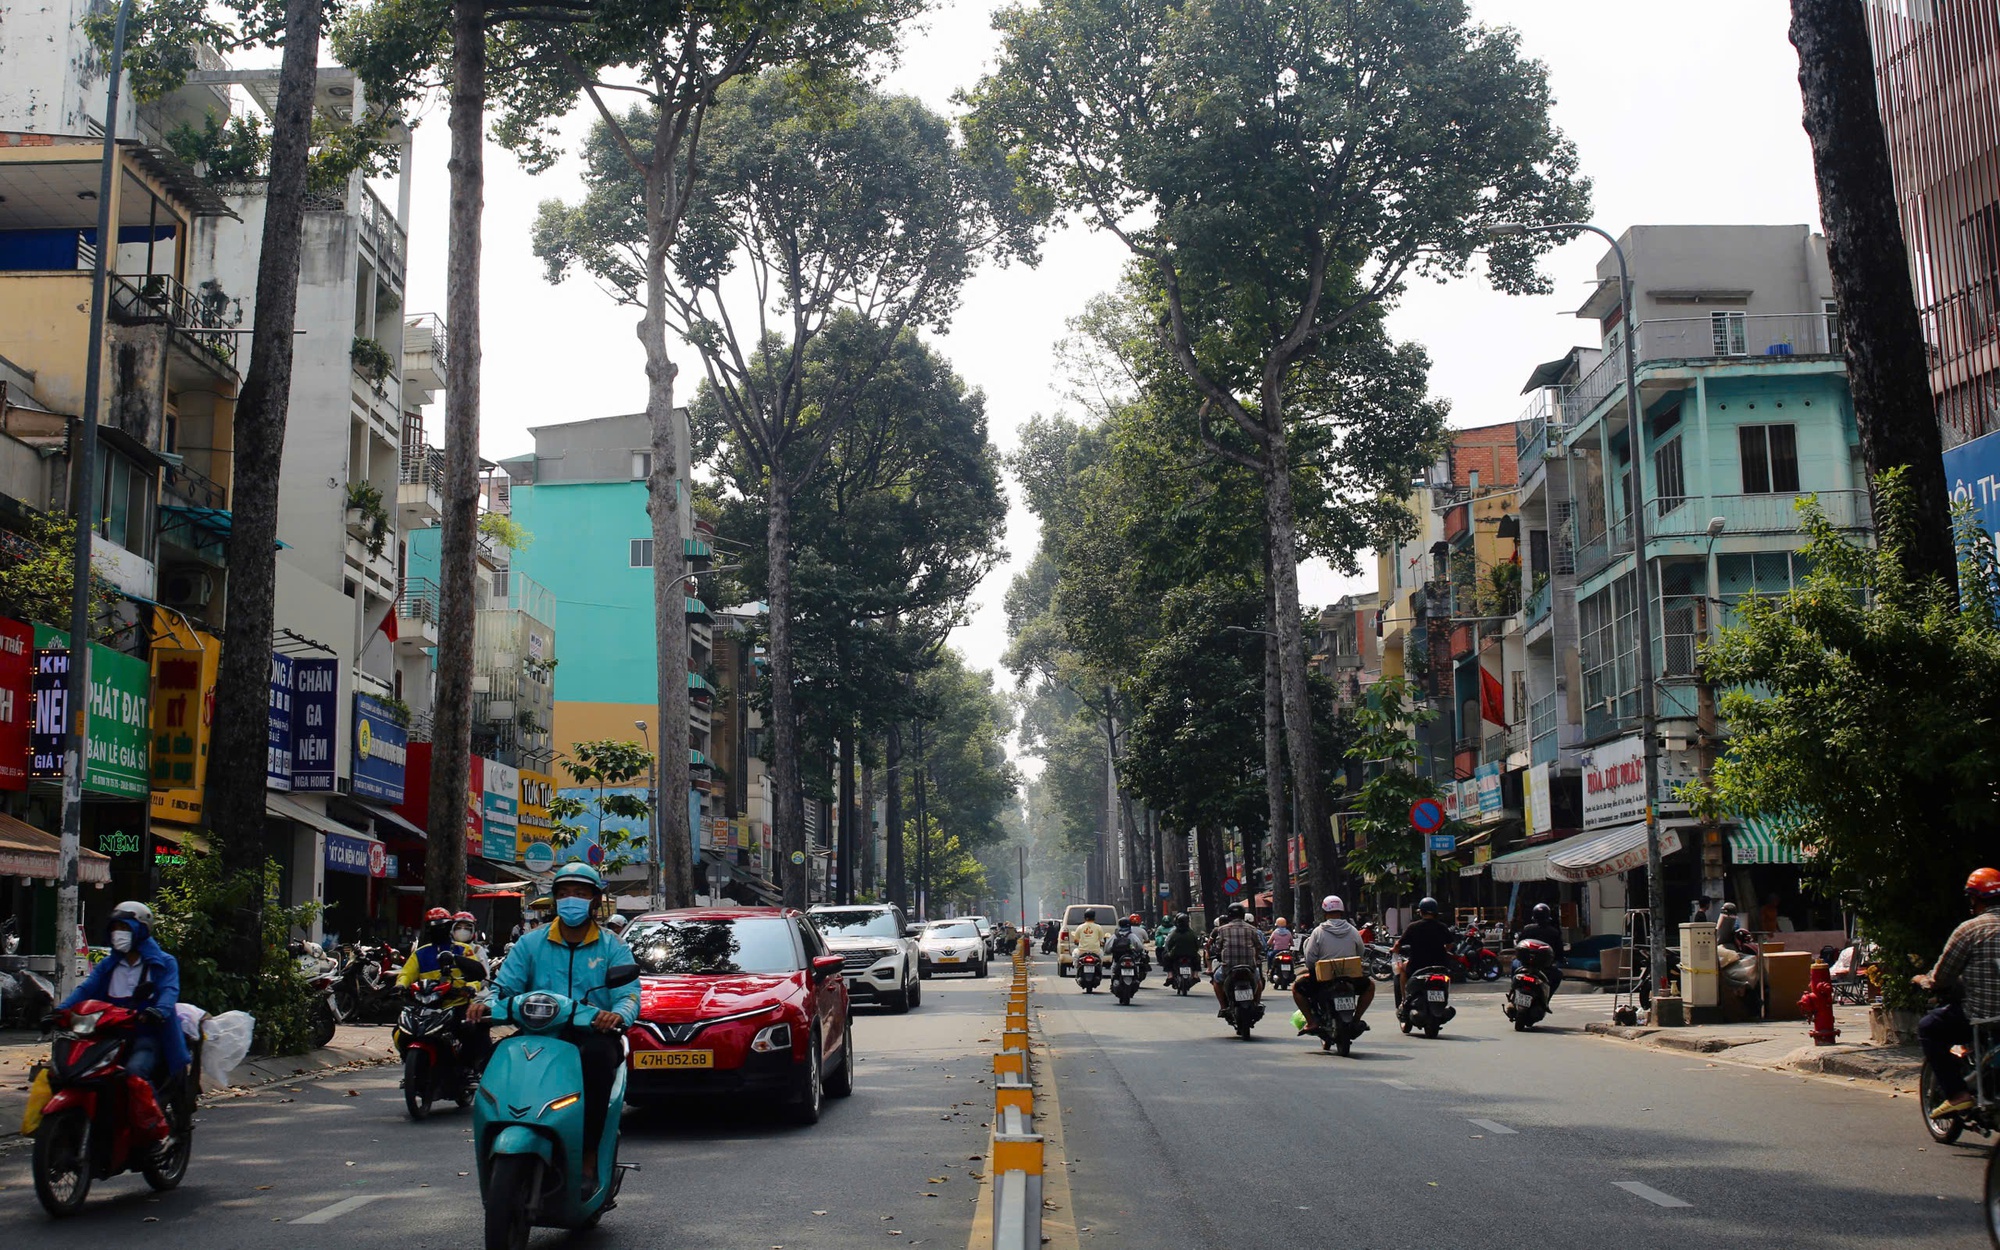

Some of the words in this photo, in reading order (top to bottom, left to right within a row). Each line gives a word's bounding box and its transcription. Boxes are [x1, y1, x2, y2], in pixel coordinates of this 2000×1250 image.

[40, 656, 69, 673] KH
[298, 666, 333, 692] CHĂN
[122, 690, 147, 736] ĐẠT
[306, 704, 323, 726] GA
[34, 751, 54, 769] GIÁ
[87, 734, 107, 762] BÁN
[120, 743, 137, 769] GIÁ
[299, 734, 328, 766] NỆM
[294, 776, 310, 788] NGA
[310, 776, 330, 788] HOME
[100, 830, 139, 856] NỆM
